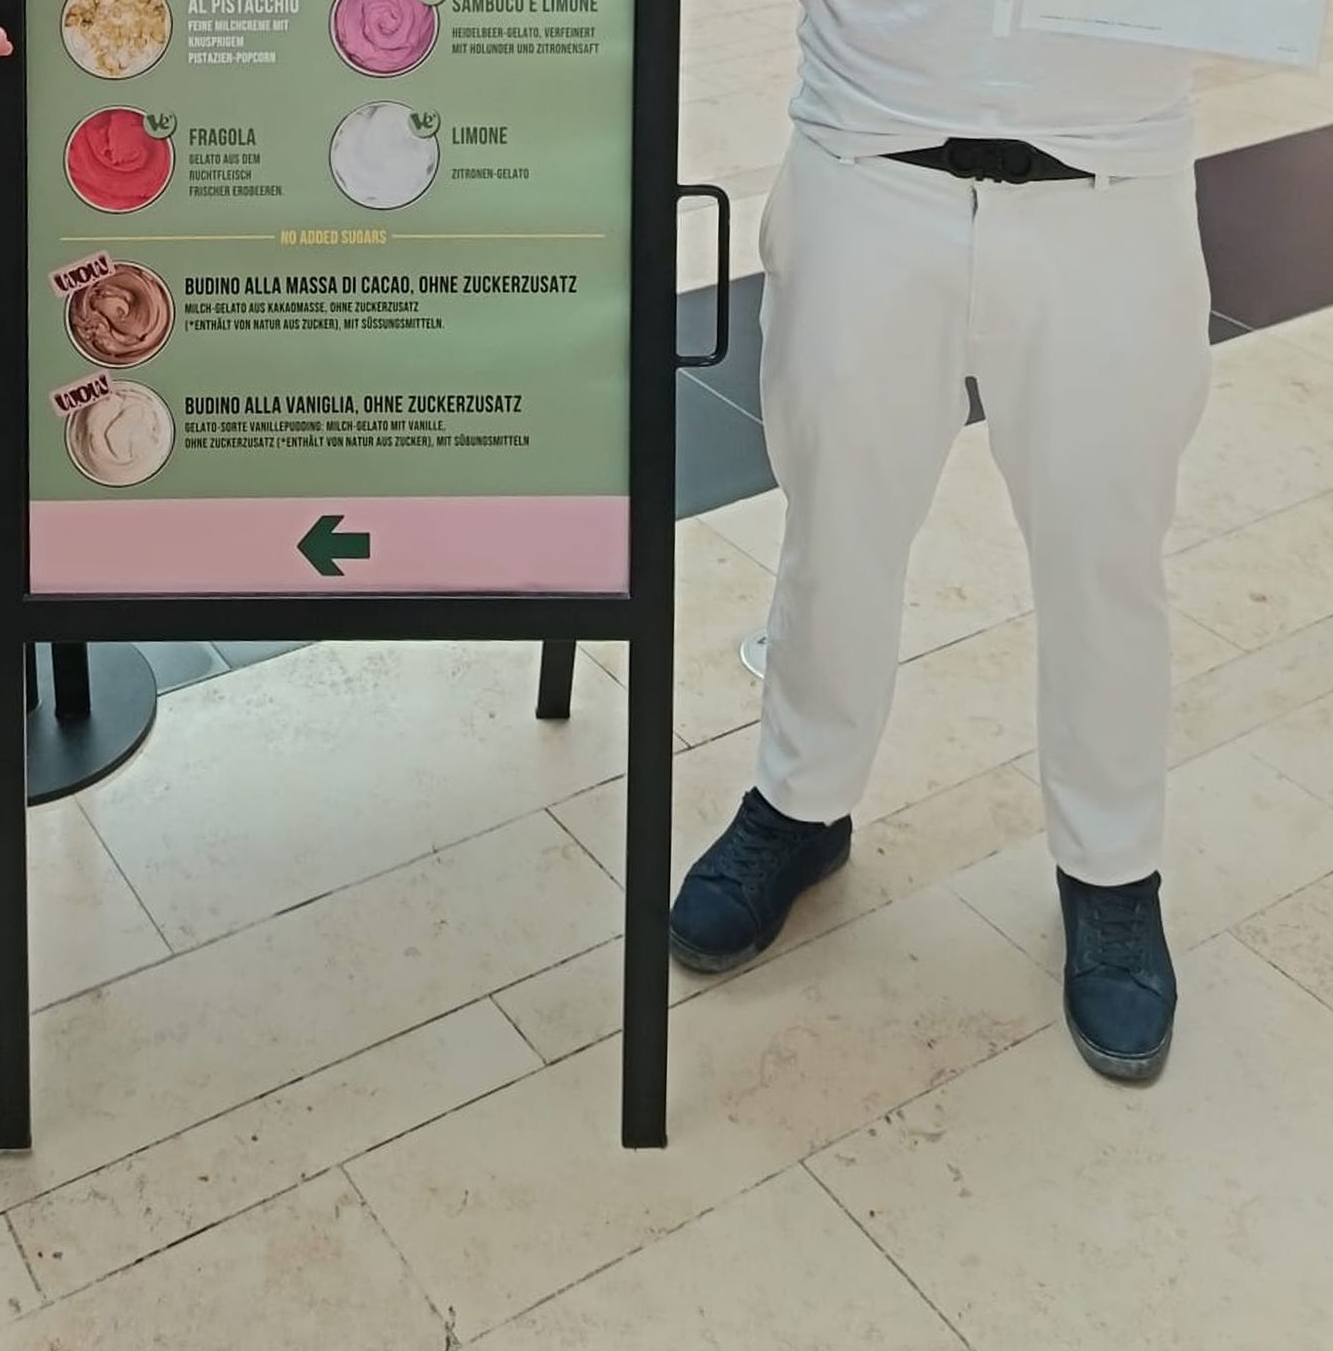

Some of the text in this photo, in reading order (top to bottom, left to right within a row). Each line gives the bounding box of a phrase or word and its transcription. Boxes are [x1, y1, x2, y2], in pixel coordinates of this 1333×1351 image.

[189, 128, 256, 146] FRAGOLA
[452, 126, 508, 145] LIMONE
[189, 154, 260, 165] GELATO AUS DEM
[451, 168, 529, 180] ZITRONEN-GELATO
[280, 230, 387, 246] NO ADDED SUGARS
[185, 275, 577, 296] BUDINO ALLA MASSA DI CACAO, OHNE ZUCKERZUSATZ
[185, 302, 247, 314] MILCH-GELATO
[249, 302, 266, 313] AUS
[330, 302, 353, 313] OHNE
[355, 301, 419, 313] ZUCKERZUSATZ
[234, 318, 251, 330] VON
[253, 318, 281, 330] NATUR
[283, 318, 300, 330] AUS
[344, 318, 359, 329] MIT
[185, 395, 522, 416] BUDINO ALLA VANIGLIA, OHNE ZUCKERZUSATZ
[185, 422, 247, 433] GELATO-SORTE
[326, 421, 388, 431] MILCH-GELATO
[390, 420, 406, 431] MIT
[185, 437, 207, 449] OHNE
[210, 436, 274, 448] ZUCKERZUSATZ
[326, 436, 343, 447] VON
[345, 436, 374, 447] NATUR
[375, 436, 392, 447] AUS
[436, 436, 452, 446] MIT
